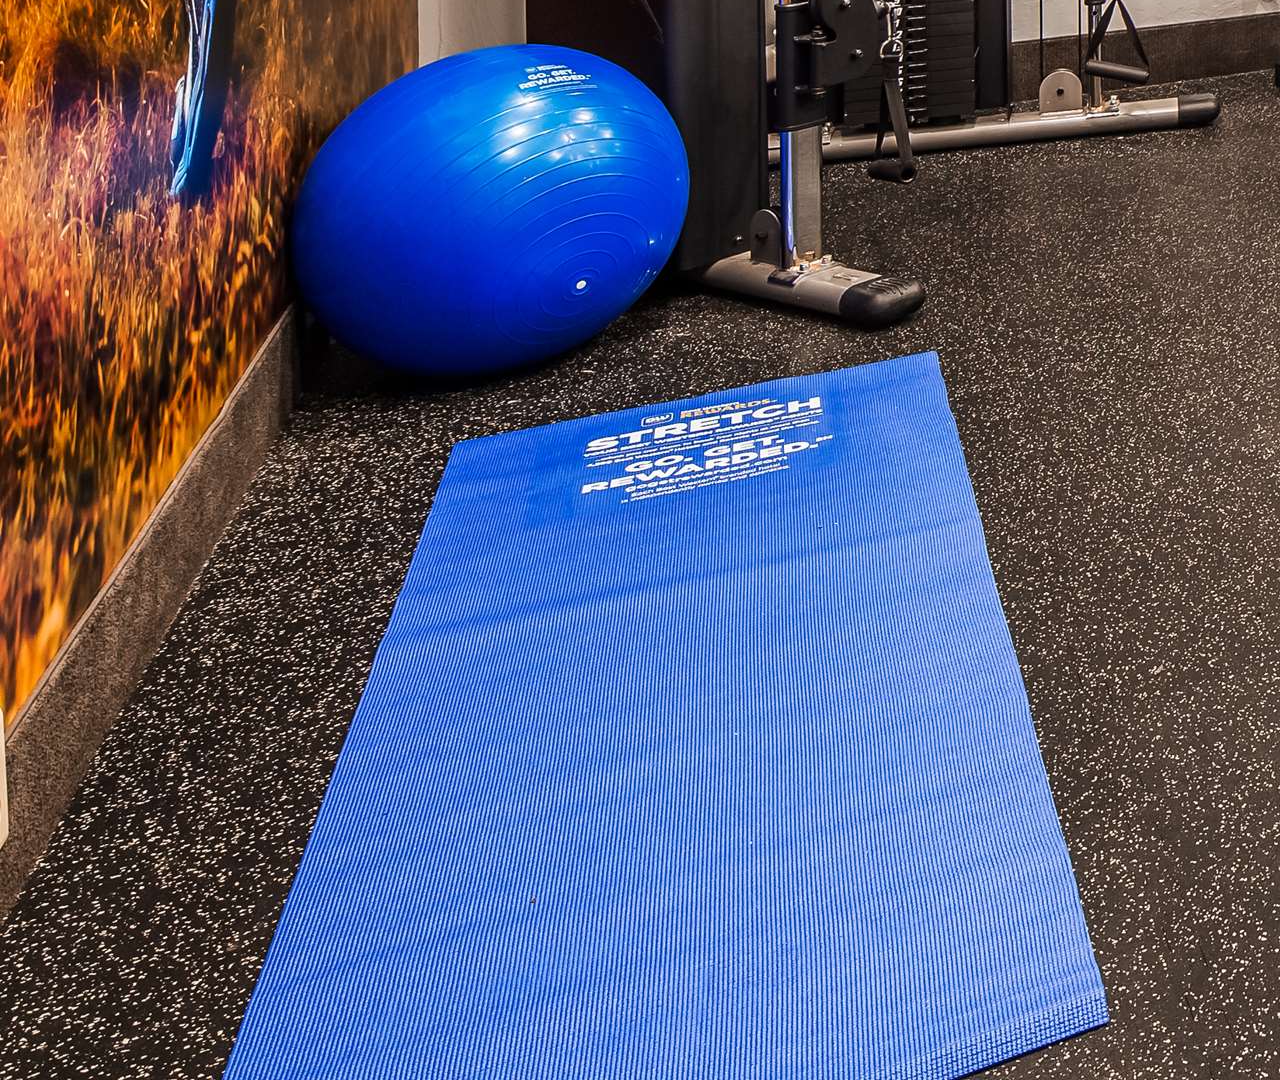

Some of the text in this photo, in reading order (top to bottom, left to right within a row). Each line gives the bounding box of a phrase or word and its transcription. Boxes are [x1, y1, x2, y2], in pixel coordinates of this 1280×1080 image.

[585, 396, 820, 452] STRETCH
[625, 455, 693, 472] GO.
[704, 435, 784, 456] GET.
